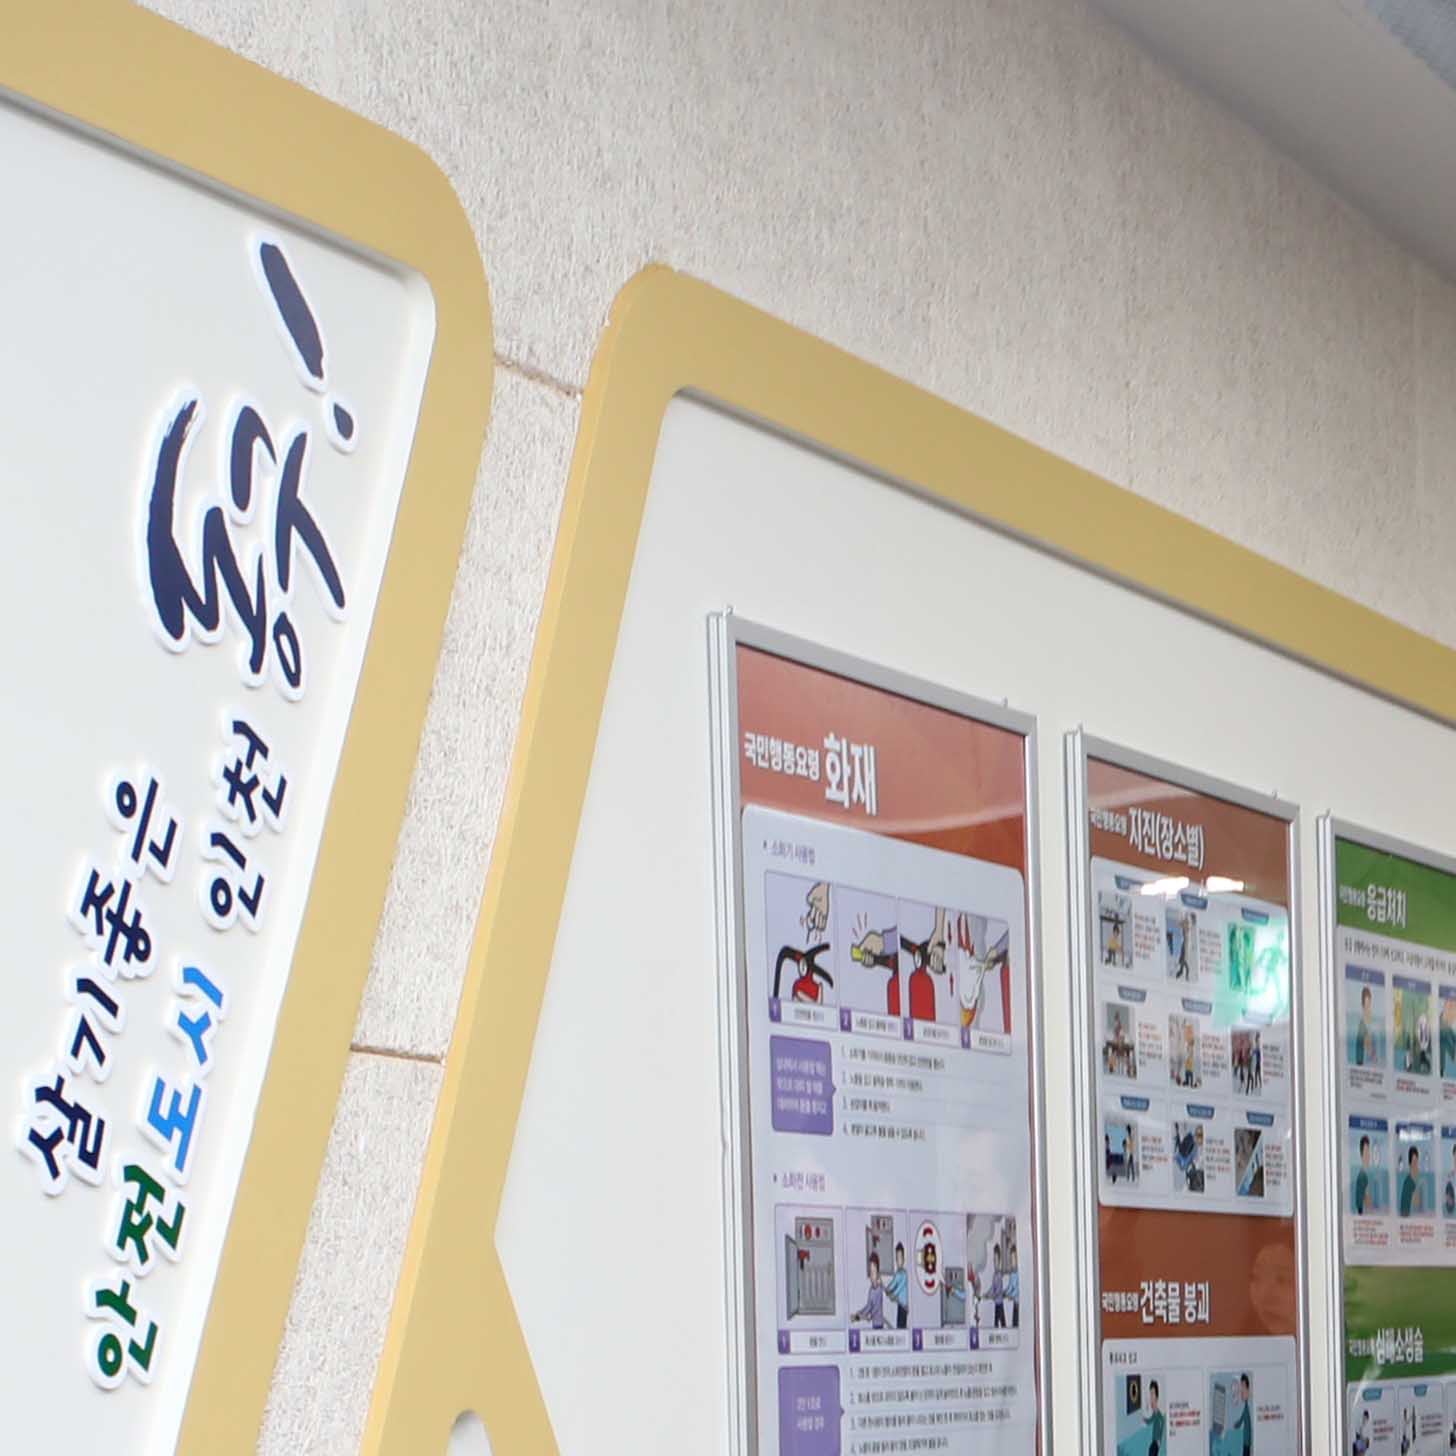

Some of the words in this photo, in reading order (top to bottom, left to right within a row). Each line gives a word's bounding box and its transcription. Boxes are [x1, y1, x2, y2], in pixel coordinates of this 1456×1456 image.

[744, 732, 820, 781] 국민행동요령
[823, 731, 878, 816] 화재
[211, 721, 286, 916] 인천
[1129, 807, 1204, 872] 지진(장소별)
[1367, 884, 1407, 929] 응급처치
[29, 779, 176, 1179] 살기좋은
[1140, 1279, 1181, 1324] 건축물
[1184, 1280, 1209, 1324] 붕괴
